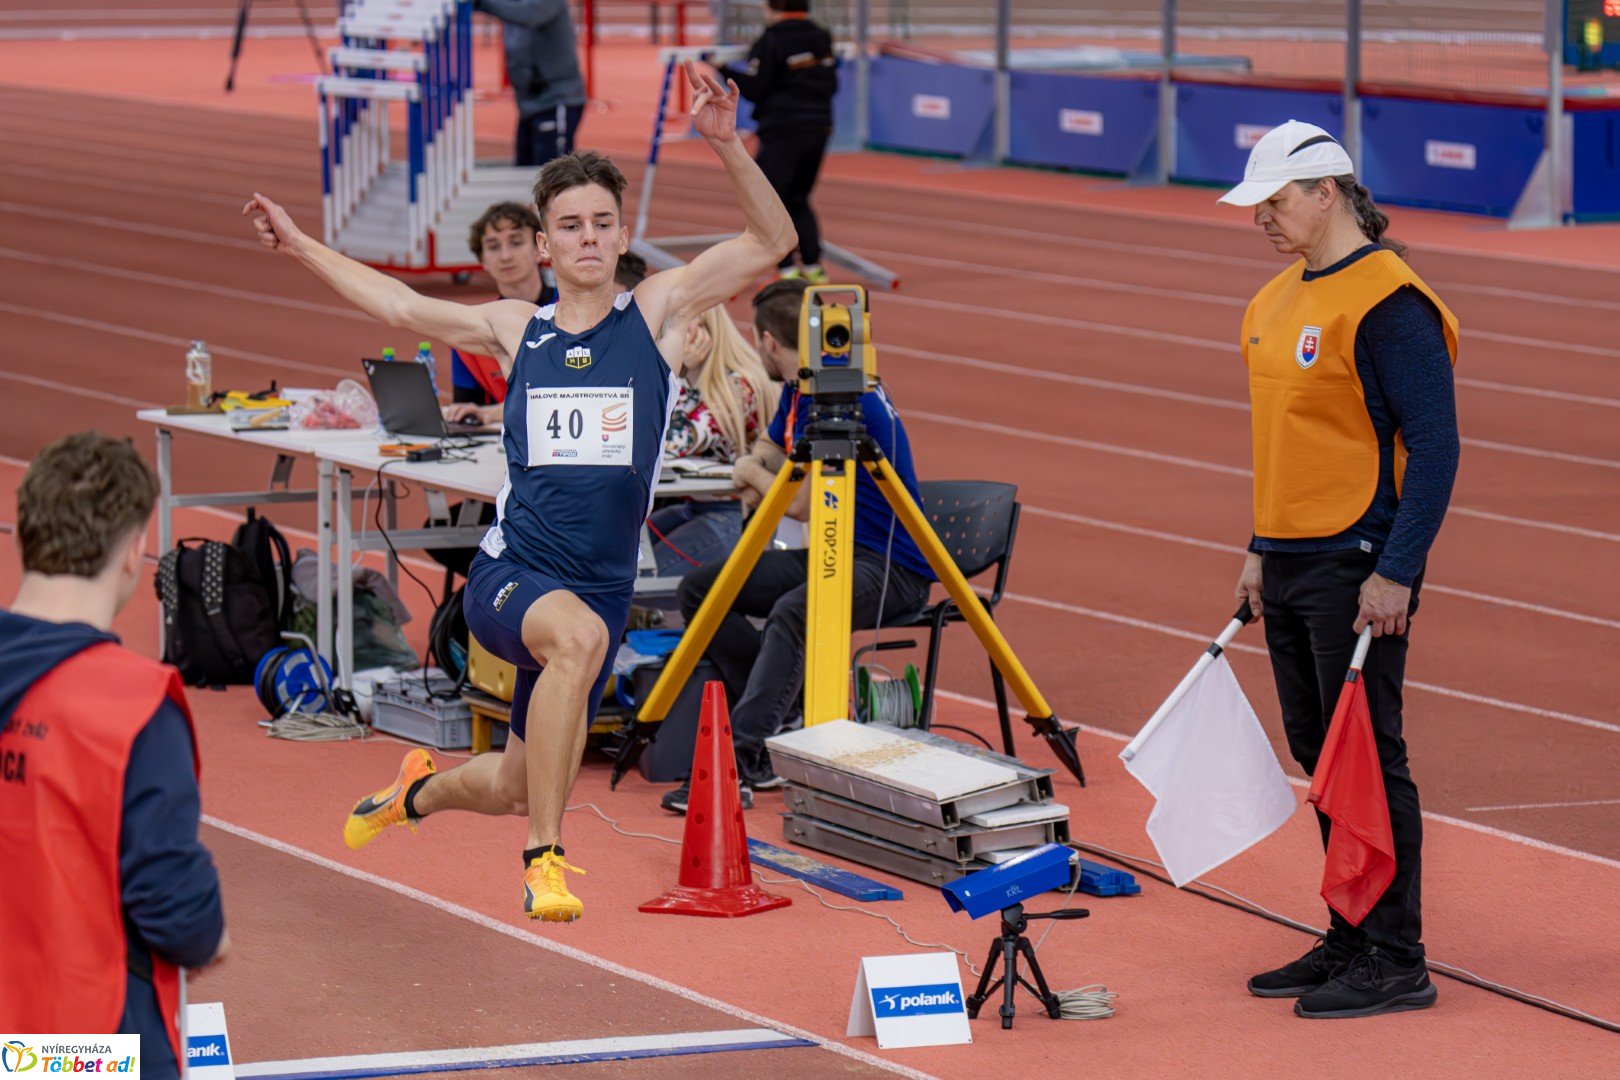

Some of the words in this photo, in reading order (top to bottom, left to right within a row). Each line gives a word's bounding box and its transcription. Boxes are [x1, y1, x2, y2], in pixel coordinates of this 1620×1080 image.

[530, 392, 558, 400] HALOVÉ
[546, 408, 583, 440] 40
[0, 749, 27, 786] CA
[900, 991, 955, 1010] polanik
